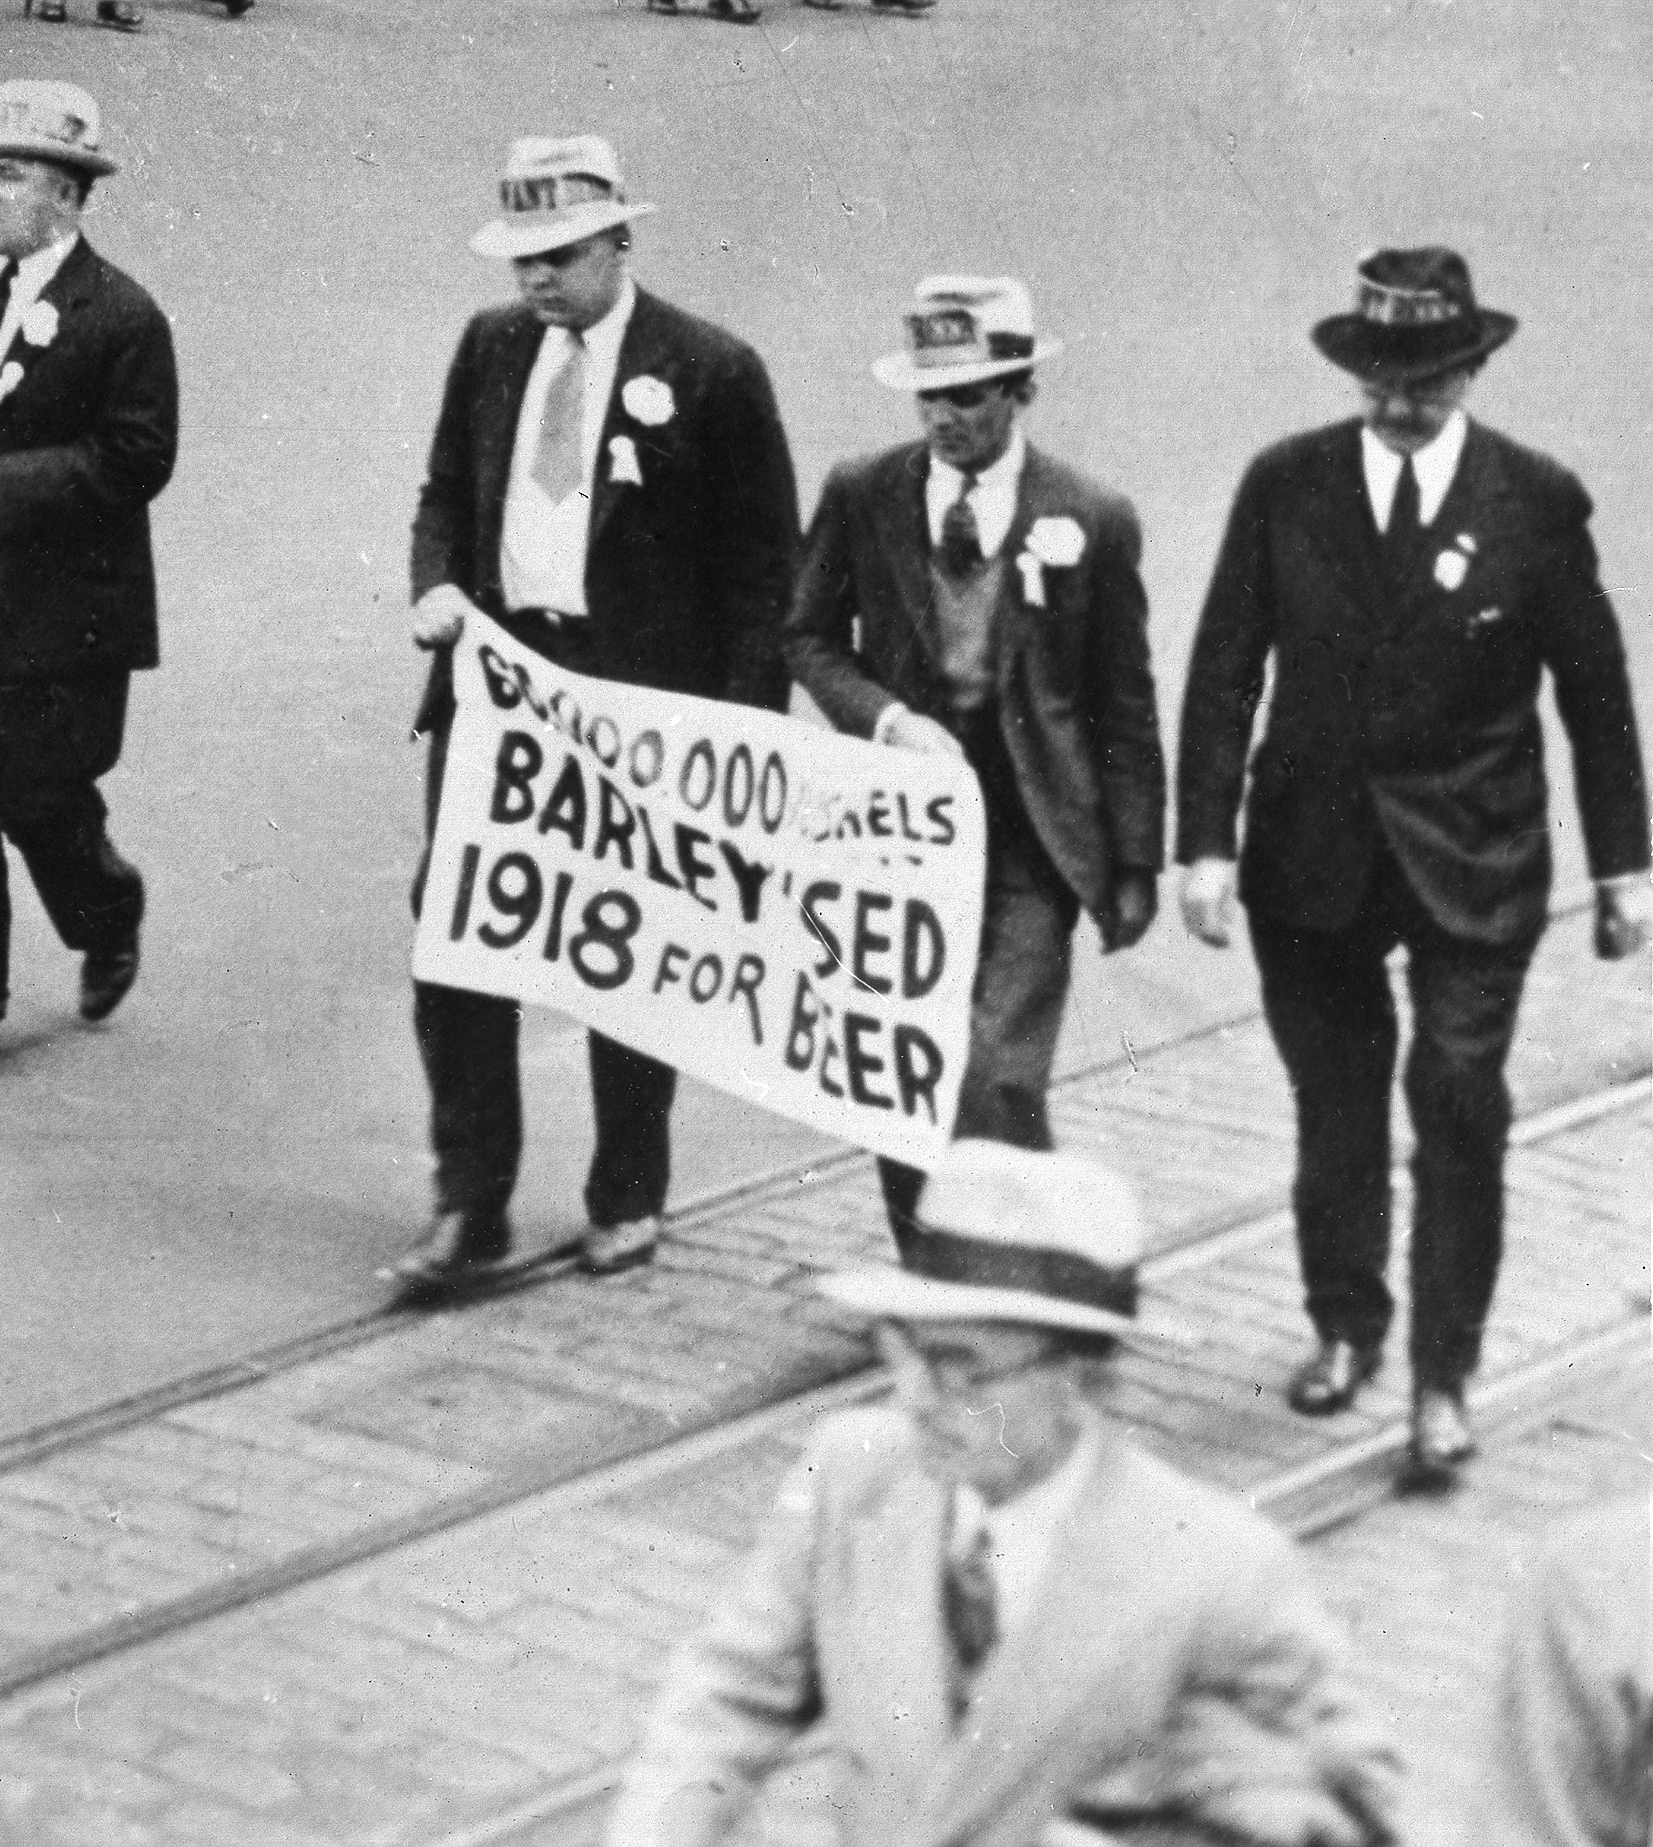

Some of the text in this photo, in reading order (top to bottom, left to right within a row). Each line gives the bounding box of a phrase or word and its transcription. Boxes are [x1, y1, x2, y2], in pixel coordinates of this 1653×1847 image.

[448, 843, 944, 1127] 1918 FOR BEER
[491, 730, 946, 1000] BARLEY SED
